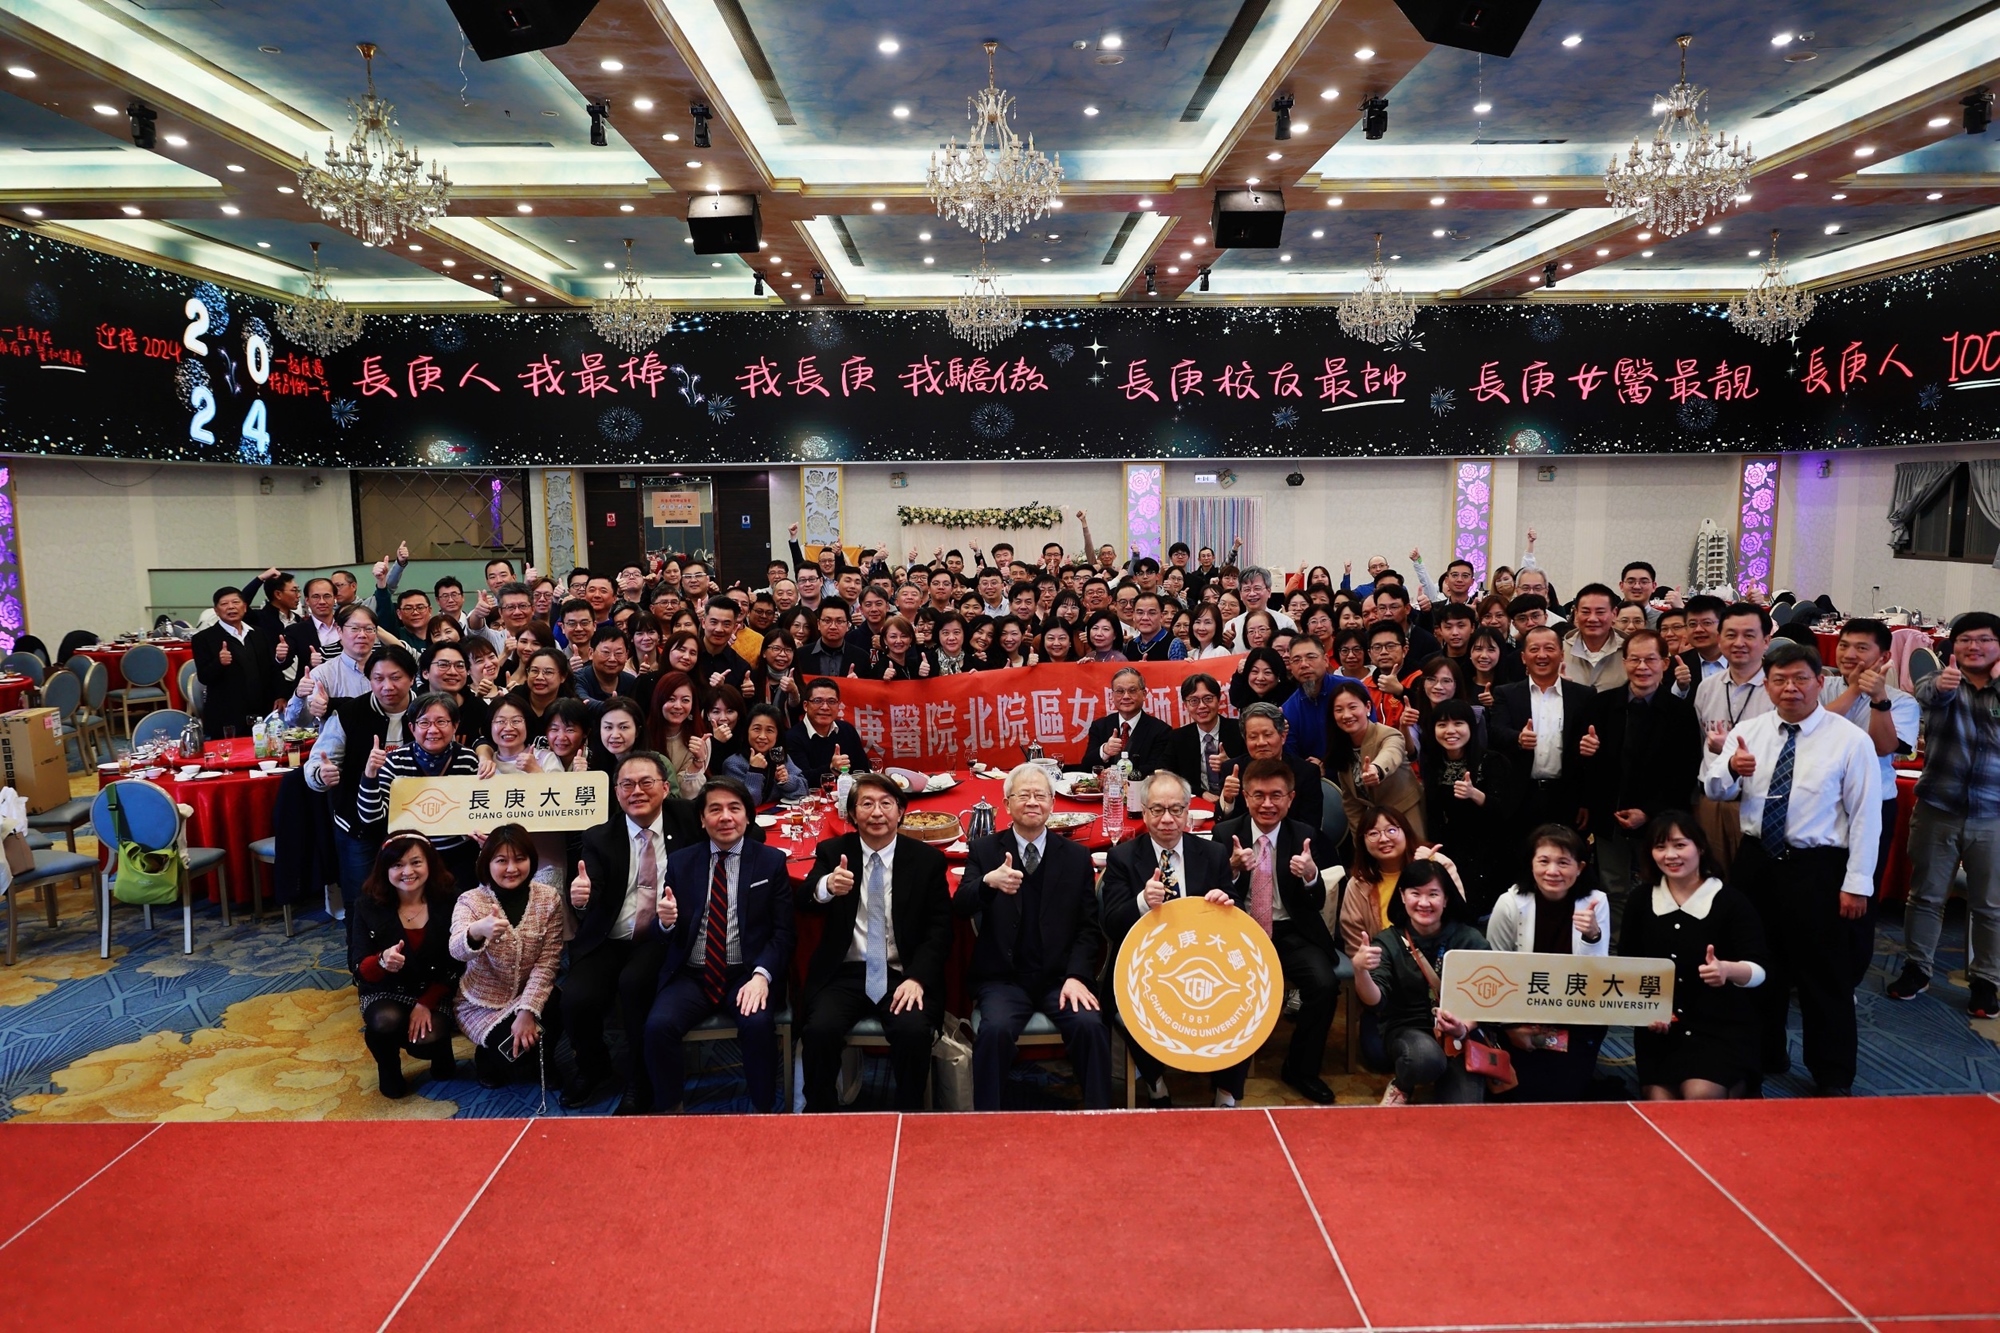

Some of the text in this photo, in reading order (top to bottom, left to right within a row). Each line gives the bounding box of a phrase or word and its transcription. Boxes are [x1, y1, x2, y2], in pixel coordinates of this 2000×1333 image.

[142, 336, 182, 363] 2024
[1800, 341, 1914, 394] 長庚人
[353, 351, 668, 398] 長庚人 我最棒
[735, 354, 1049, 398] 我長庚 我驕傲
[1117, 357, 1407, 402] 長庚校友最帥
[1468, 357, 1759, 404] 長庚女醫最靚
[468, 808, 596, 820] CHANG GUNG UNIVERSITY
[469, 786, 596, 810] 長庚大學
[1155, 929, 1246, 971] 長庚大學
[1527, 971, 1661, 998] 長庚大學
[1527, 997, 1660, 1010] CHANG GUNG UNIVERSITY
[1149, 994, 1246, 1037] CHANG GUNG UNIVERSITY
[1181, 1012, 1210, 1024] 1987
